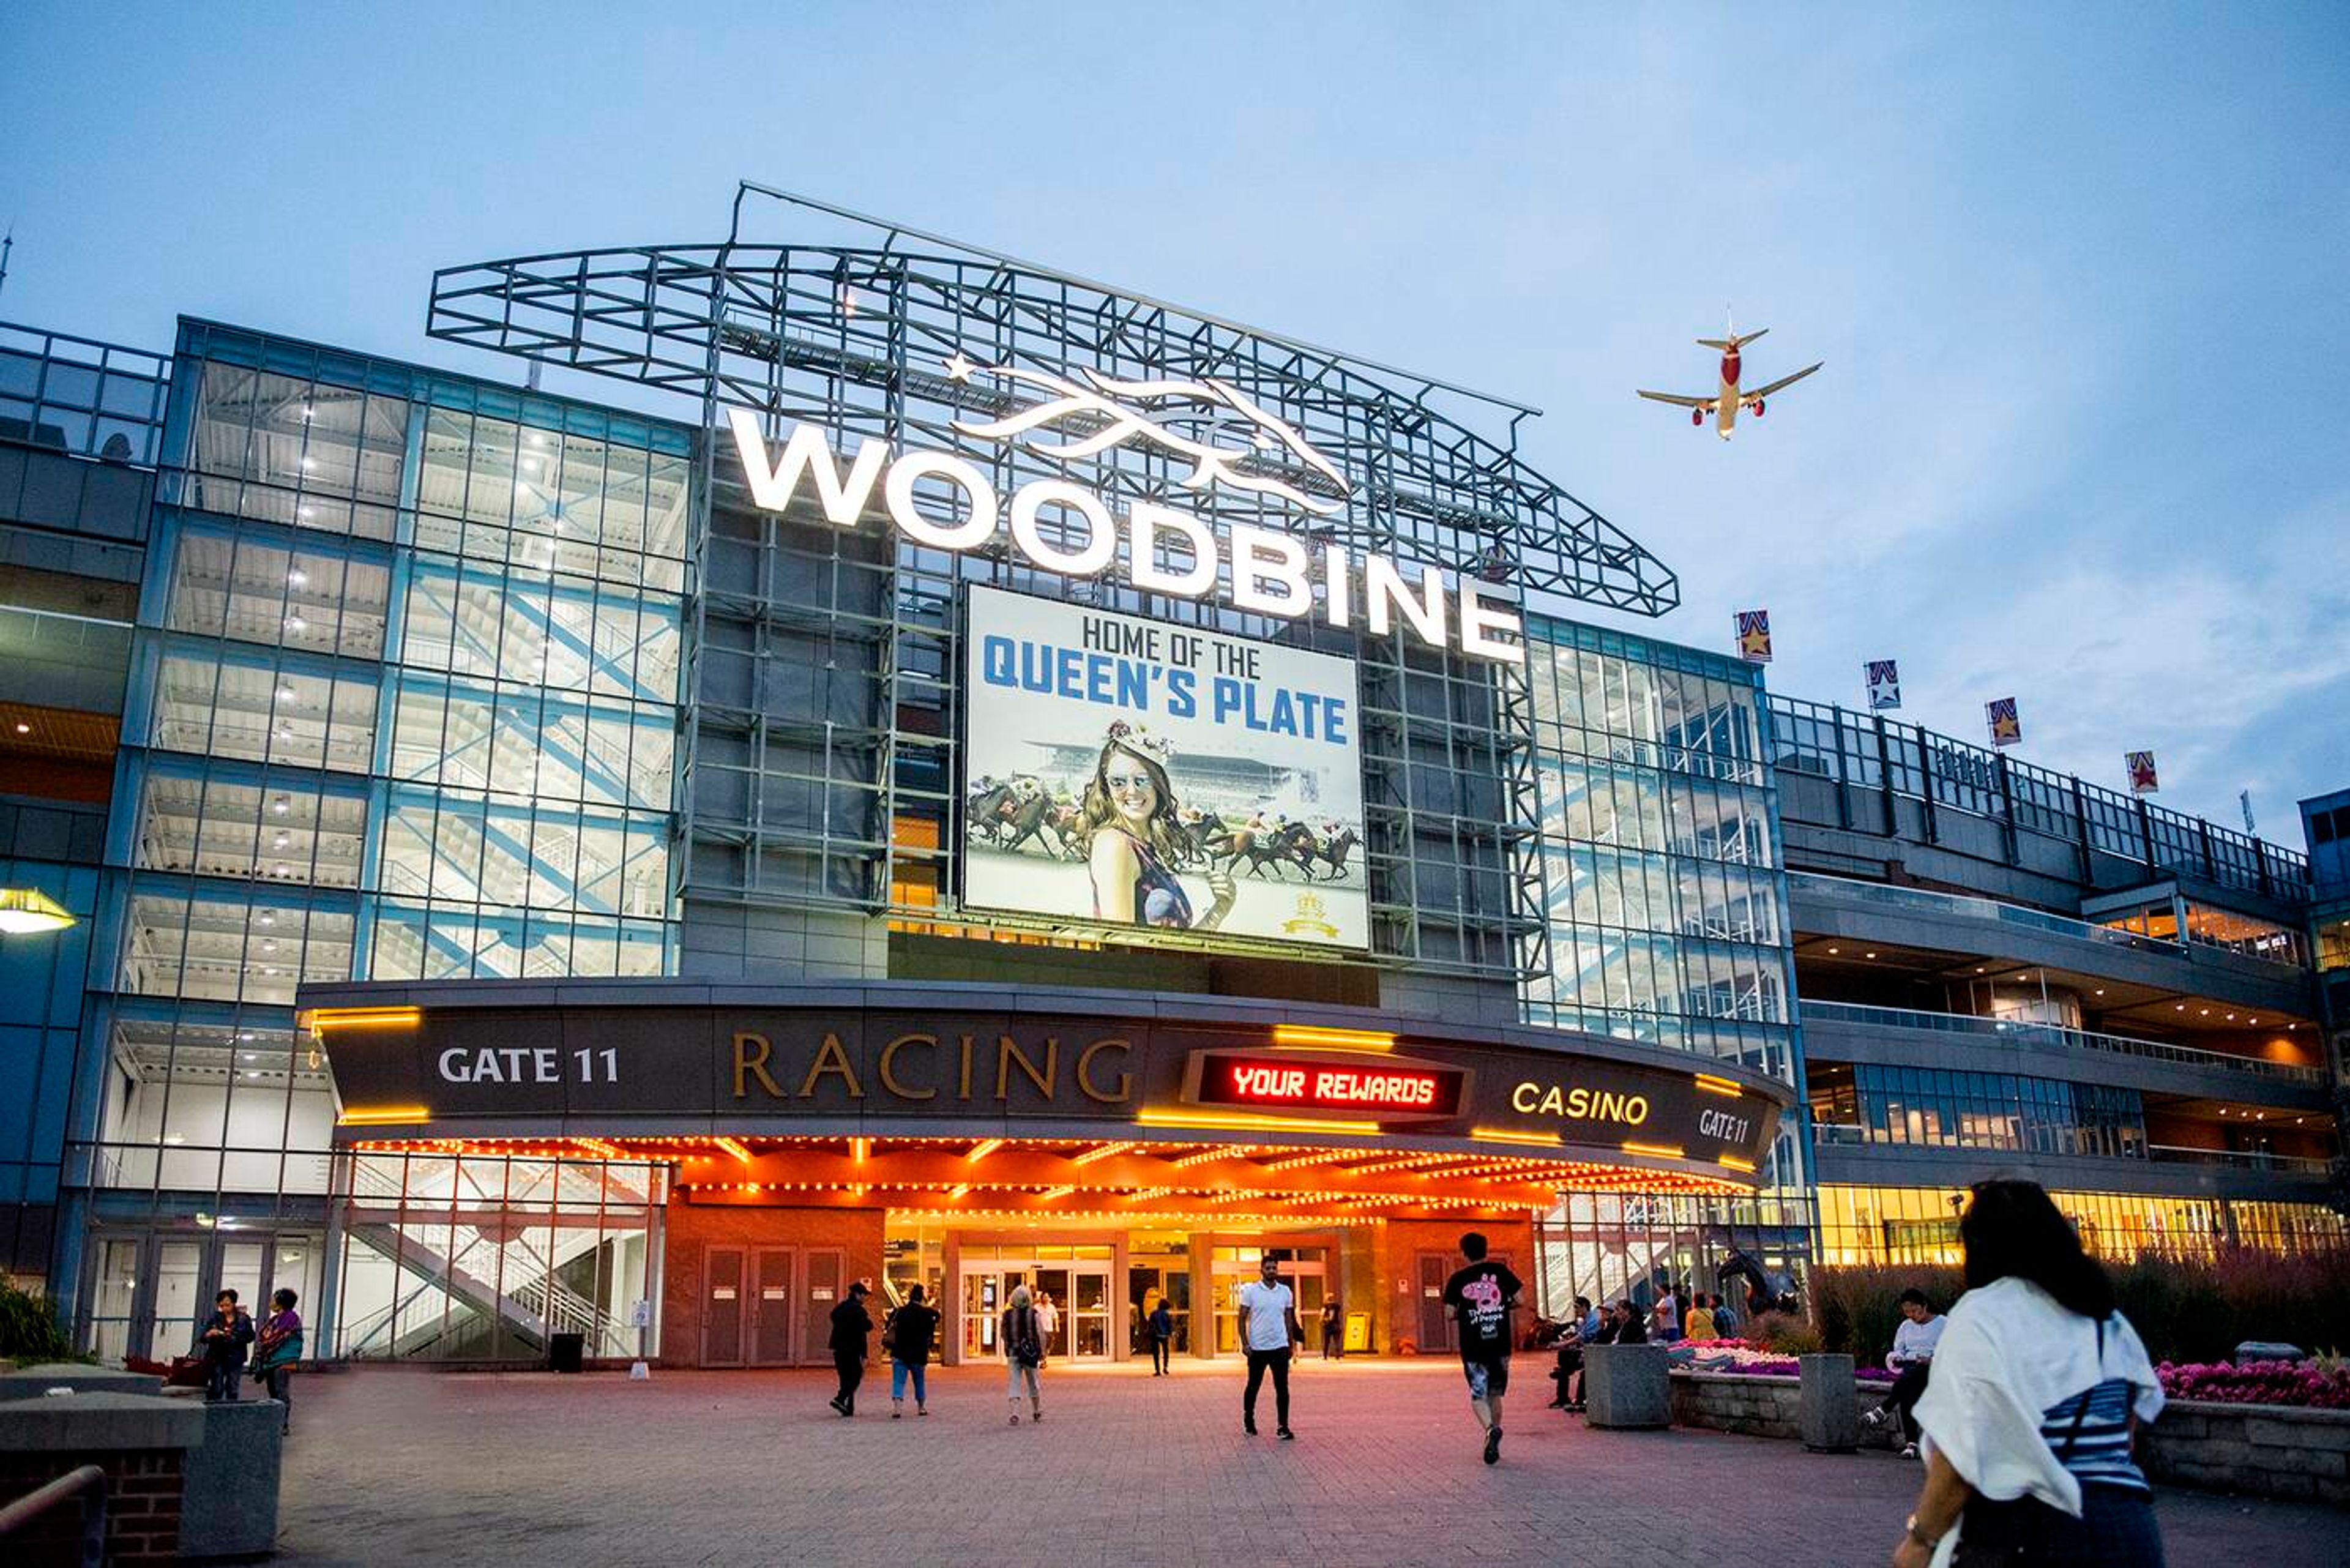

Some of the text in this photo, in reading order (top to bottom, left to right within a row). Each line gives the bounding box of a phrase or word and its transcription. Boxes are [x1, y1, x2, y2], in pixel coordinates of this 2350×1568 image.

[726, 408, 1526, 663] WOODBINE
[1083, 616, 1261, 680] HOME OF THE
[983, 634, 1348, 745] QUEEN'S PLATE
[438, 1047, 617, 1083] GATE 11
[733, 1032, 1132, 1102] RACING
[1234, 1067, 1436, 1104] YOUR REWARDS
[1512, 1082, 1649, 1125] CASINO
[1699, 1108, 1748, 1143] GATE 11
